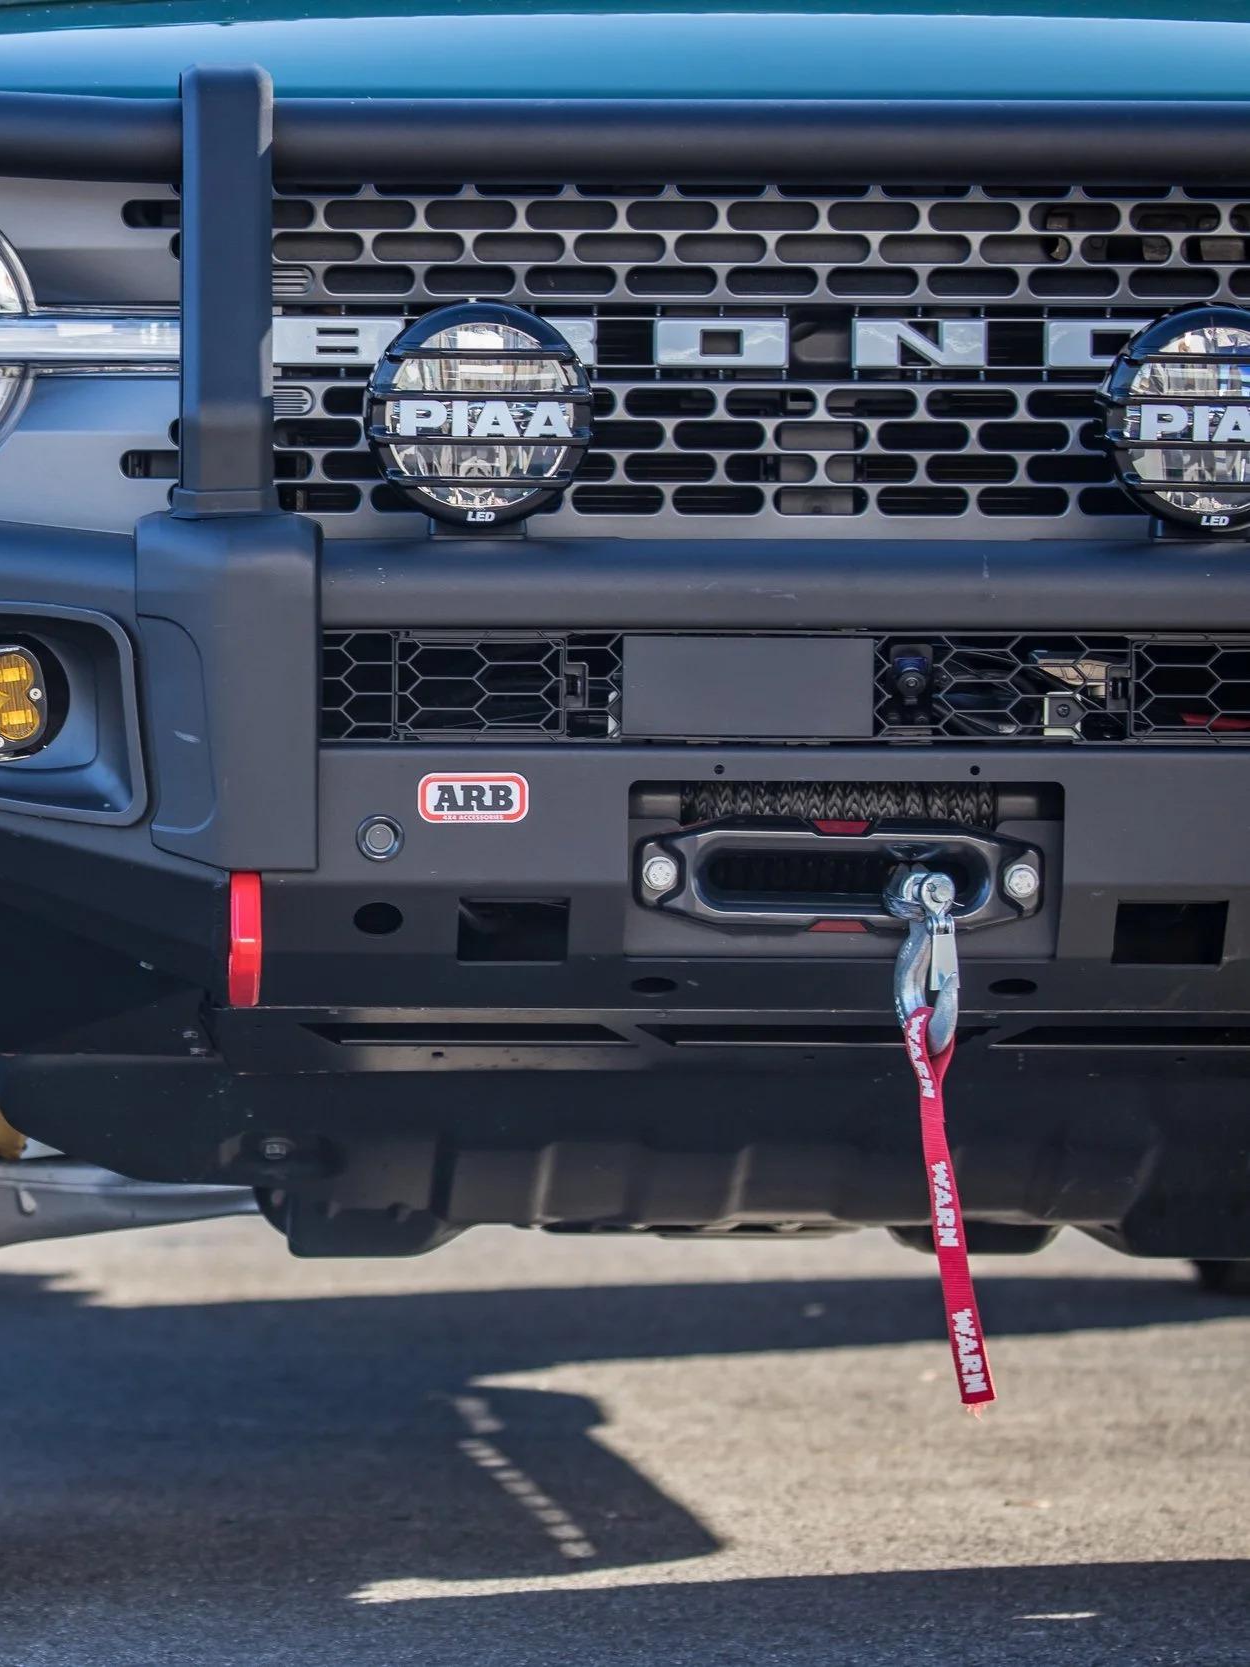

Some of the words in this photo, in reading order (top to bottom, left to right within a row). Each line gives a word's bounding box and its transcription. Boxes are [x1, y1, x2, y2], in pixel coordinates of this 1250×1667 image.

[399, 399, 573, 438] PIAA
[466, 511, 496, 523] LED
[1200, 515, 1230, 527] LED
[433, 784, 514, 812] ARB
[931, 1160, 960, 1247] WARN
[951, 1308, 989, 1394] WARN
